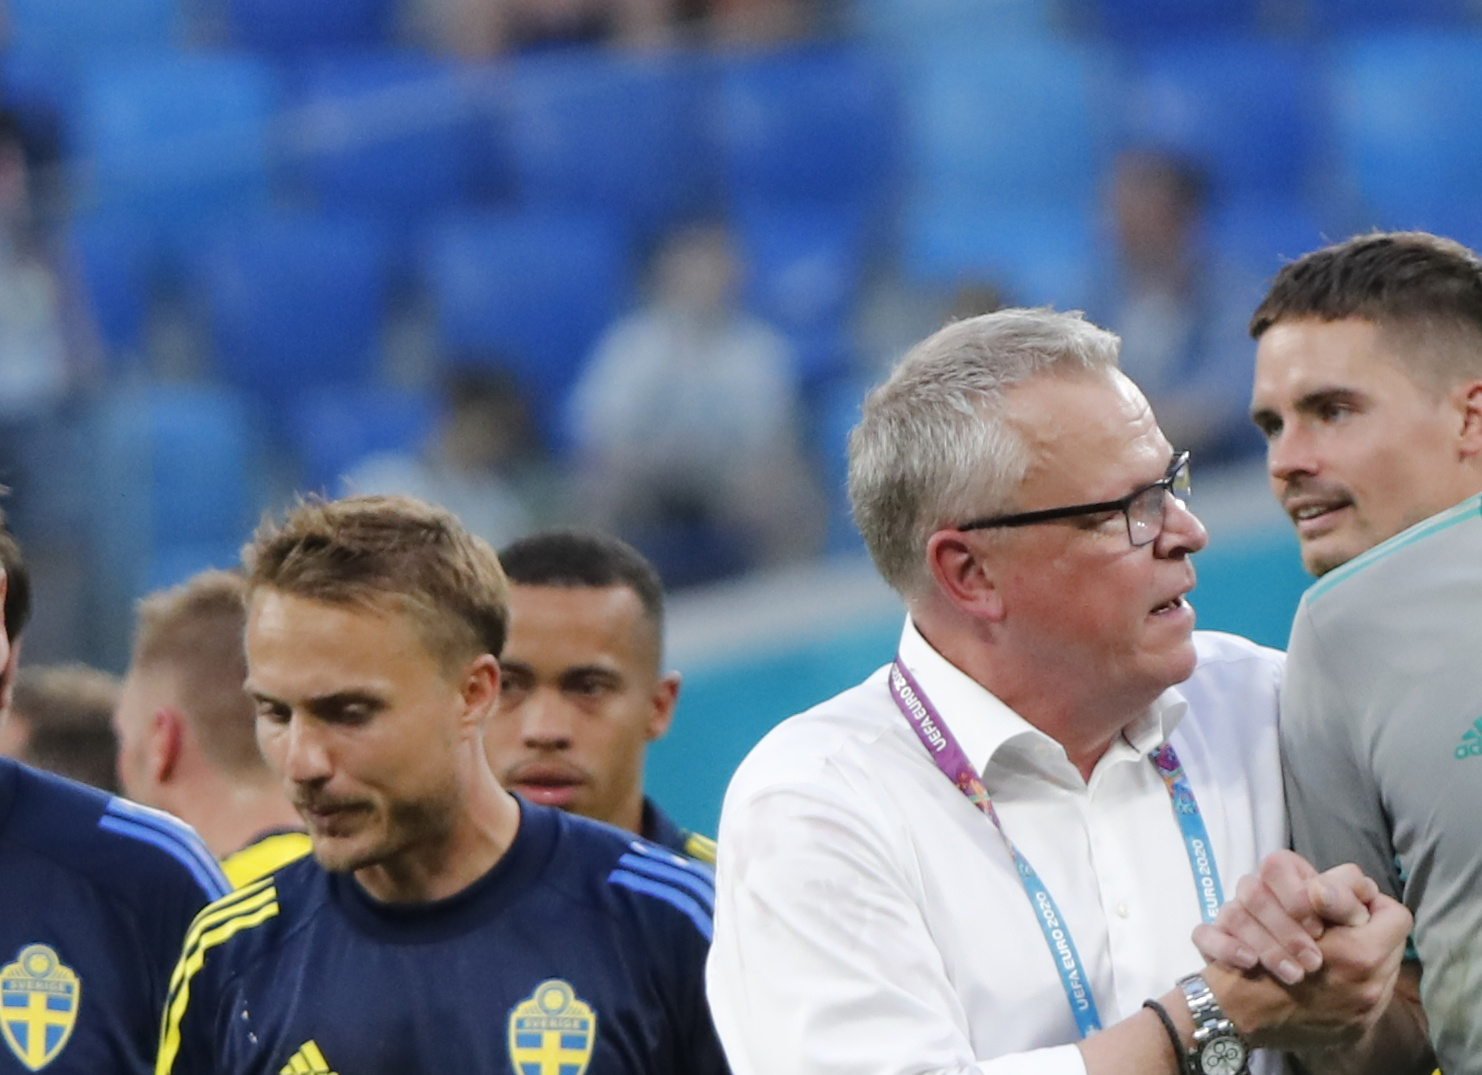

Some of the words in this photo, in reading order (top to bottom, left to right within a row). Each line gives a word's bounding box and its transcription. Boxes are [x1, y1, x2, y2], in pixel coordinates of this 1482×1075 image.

[900, 686, 927, 720] EURO
[920, 714, 947, 752] UEFA
[1192, 838, 1211, 875] 2020
[1036, 891, 1060, 928] 2020
[1201, 876, 1219, 918] EURO
[1051, 928, 1076, 970] EURO
[1068, 968, 1090, 1011] UEFA
